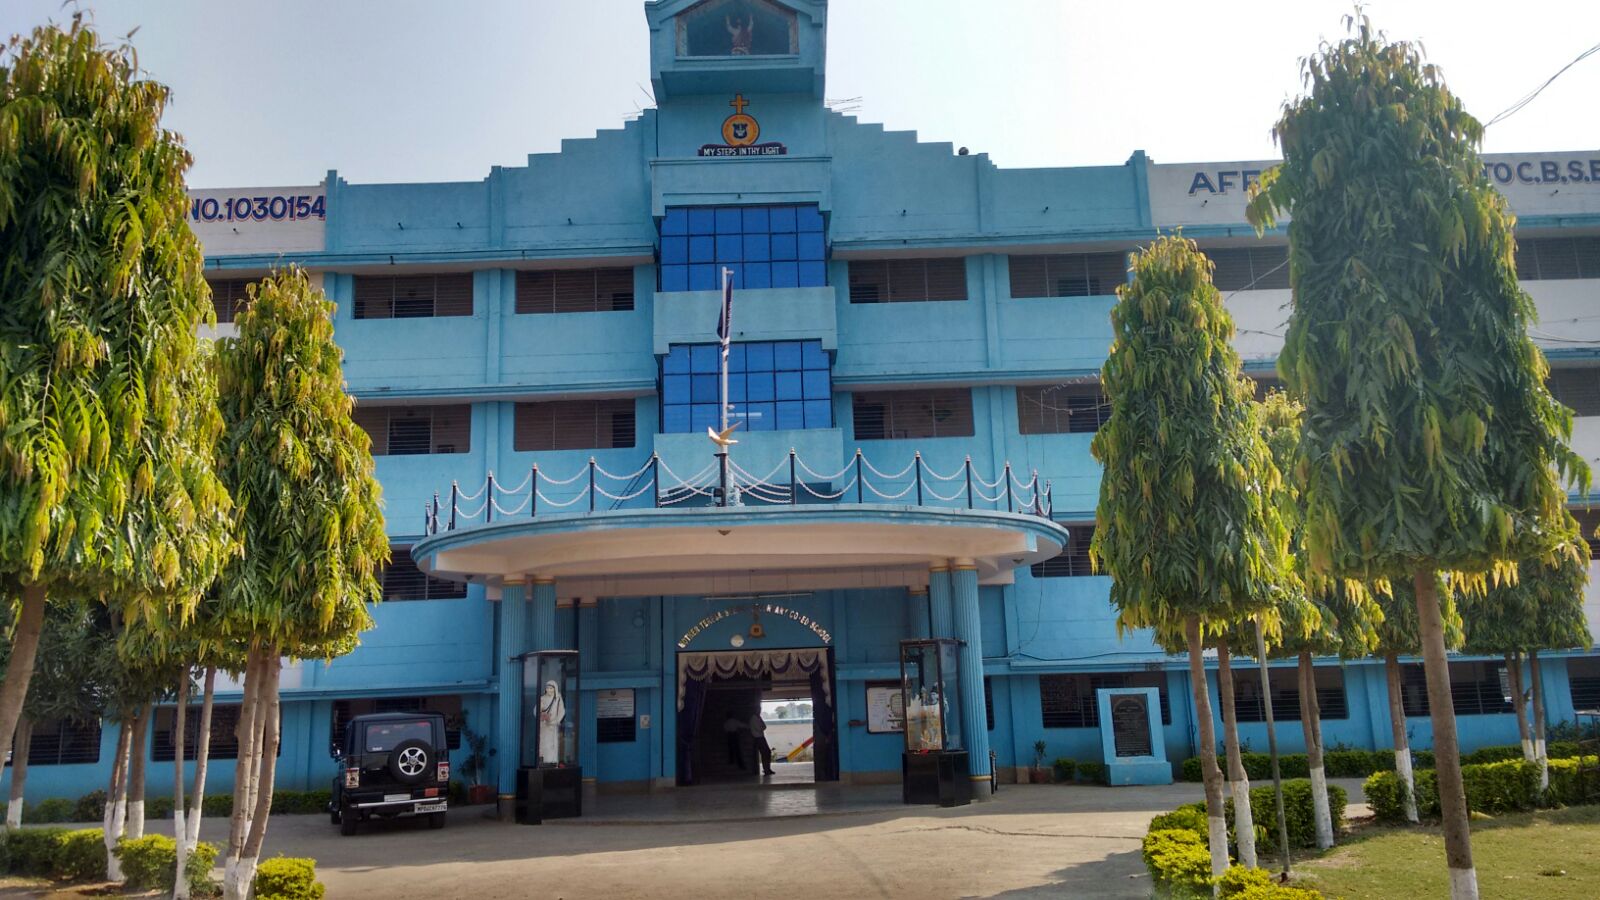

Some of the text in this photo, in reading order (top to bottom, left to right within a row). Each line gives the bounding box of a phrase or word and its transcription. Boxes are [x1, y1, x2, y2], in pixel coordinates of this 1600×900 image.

[703, 146, 780, 156] MY STEPS IN THY LIGHT
